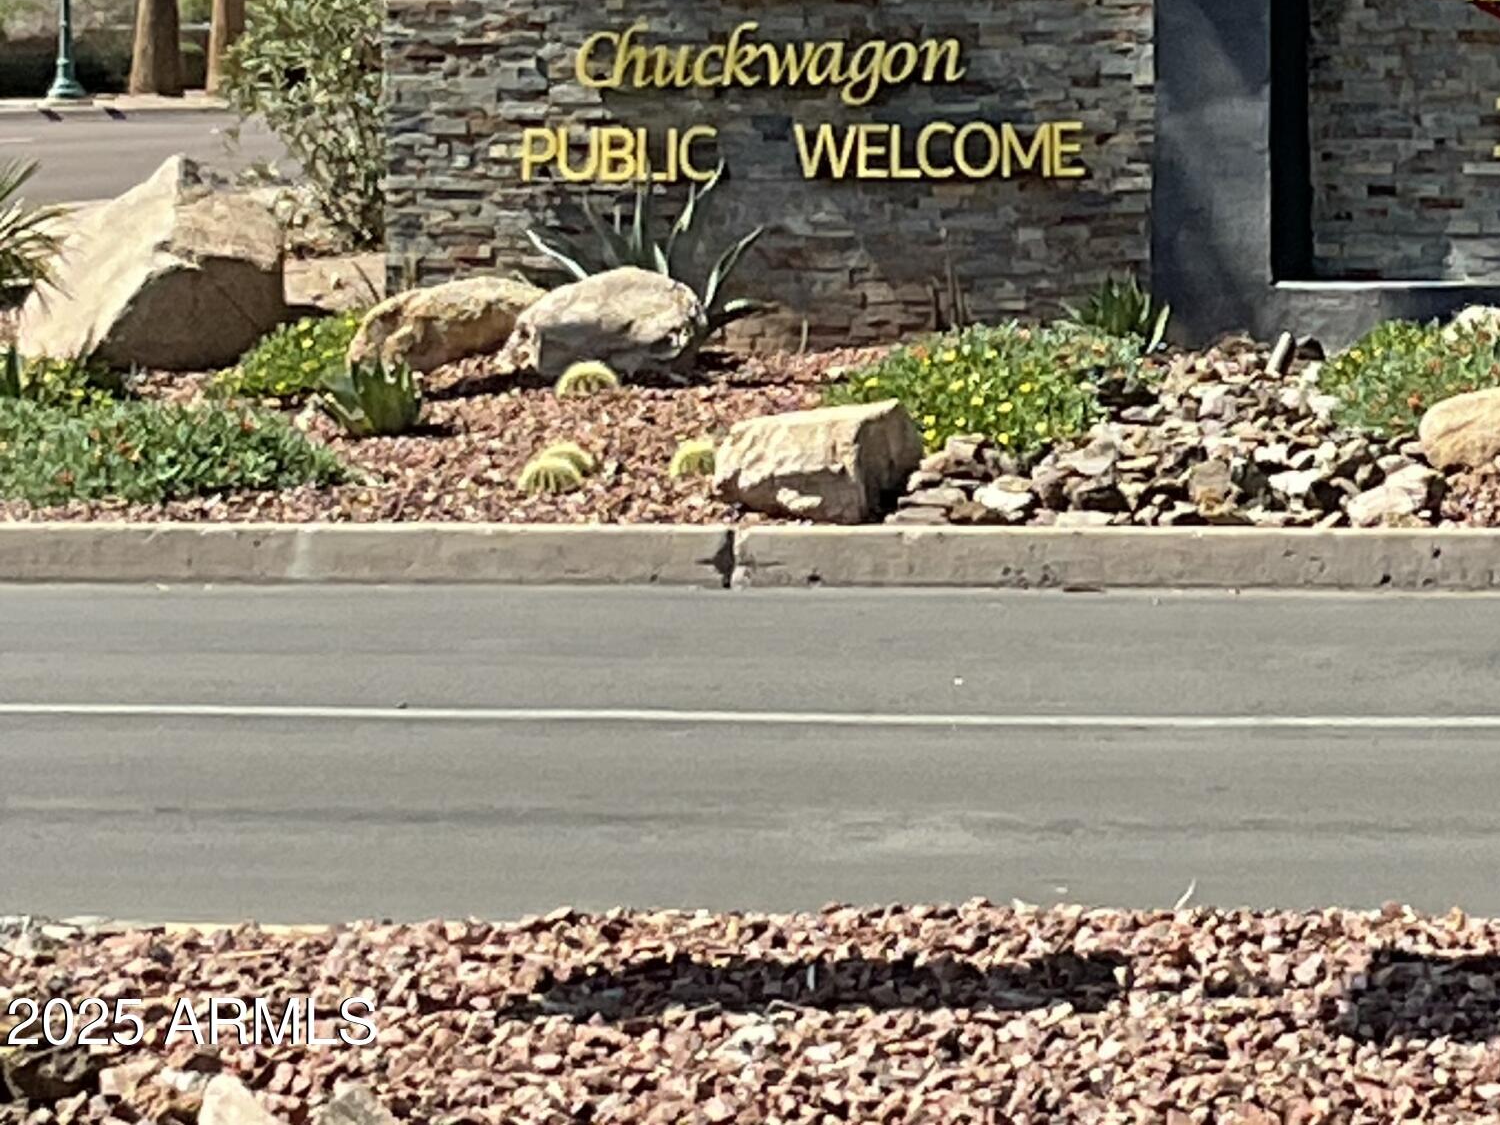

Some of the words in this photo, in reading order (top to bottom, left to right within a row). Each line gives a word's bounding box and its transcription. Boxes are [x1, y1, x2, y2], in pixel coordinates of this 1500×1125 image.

[574, 21, 966, 106] Chuckwagon
[519, 125, 718, 184] PUBLIC
[795, 121, 1086, 179] WELCOME
